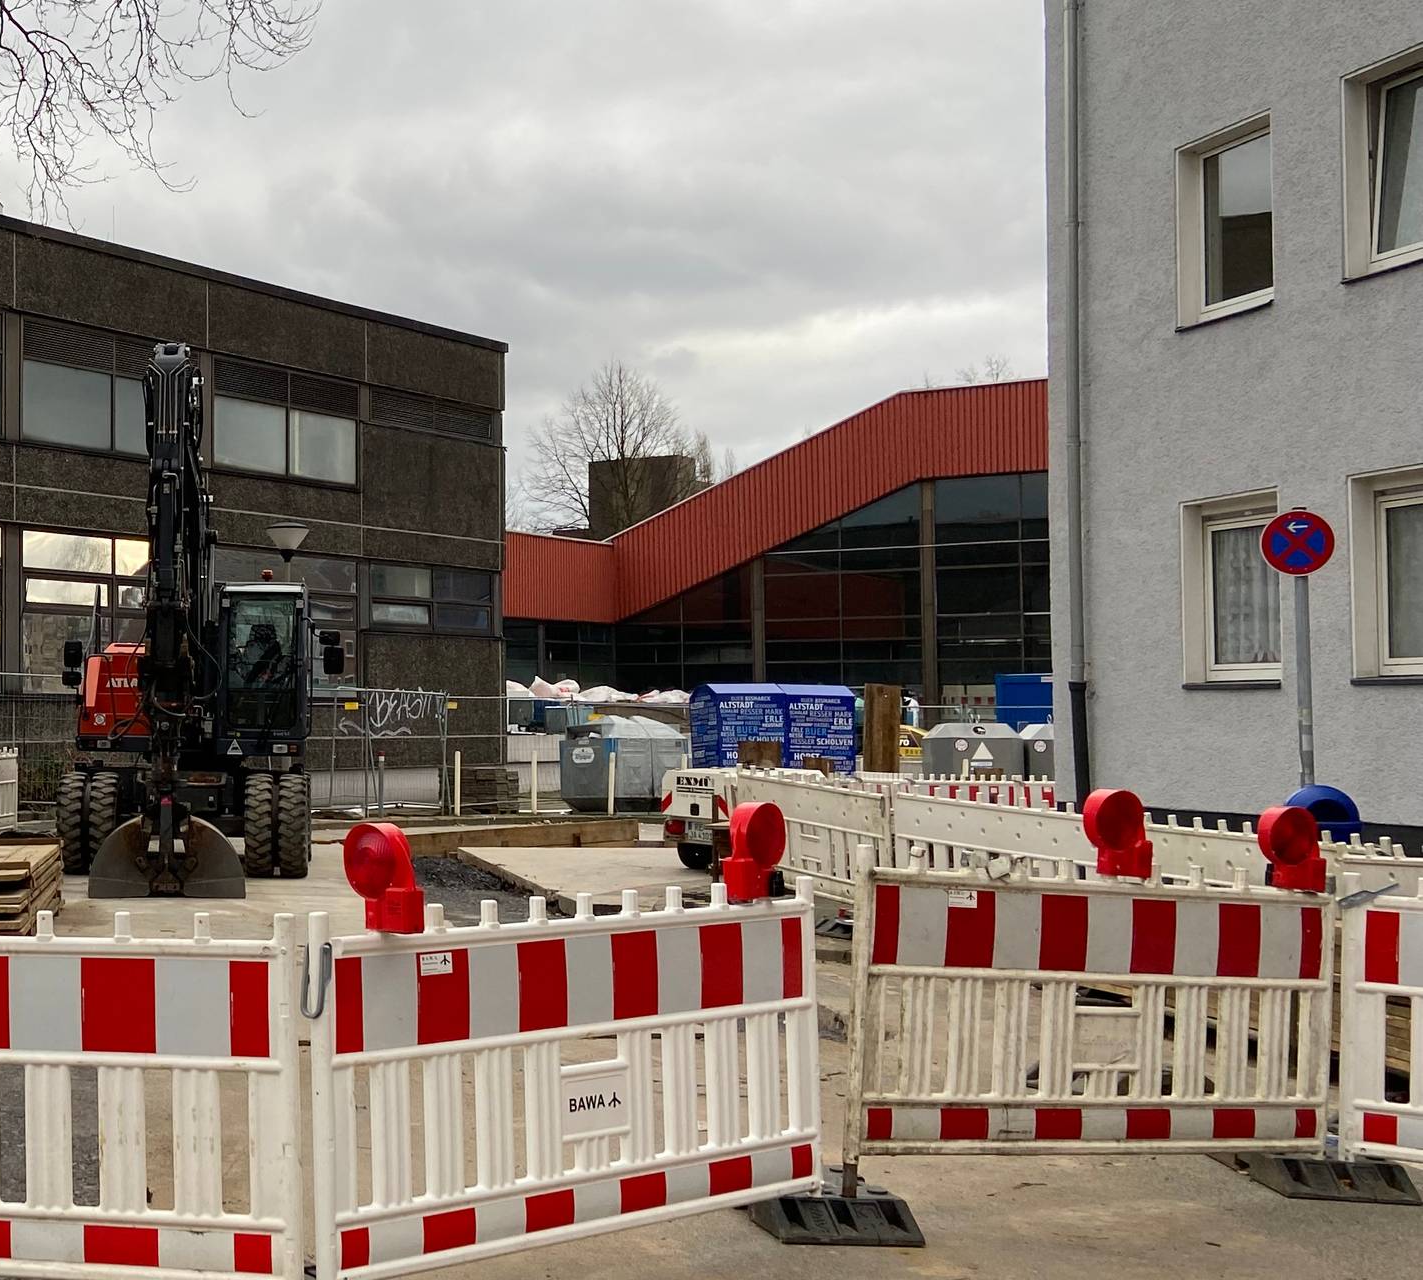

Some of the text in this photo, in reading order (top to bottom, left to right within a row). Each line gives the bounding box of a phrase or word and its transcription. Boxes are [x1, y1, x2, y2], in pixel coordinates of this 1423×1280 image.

[105, 677, 138, 688] ATLA
[719, 701, 754, 709] ALTSTADT
[788, 702, 824, 710] ALTSTADT
[764, 715, 784, 723] ERLE
[833, 717, 853, 726] ERLE
[737, 726, 759, 734] BUER
[804, 727, 827, 736] BUER
[816, 738, 854, 746] SCHOLVEN
[569, 1094, 606, 1113] BAWA
